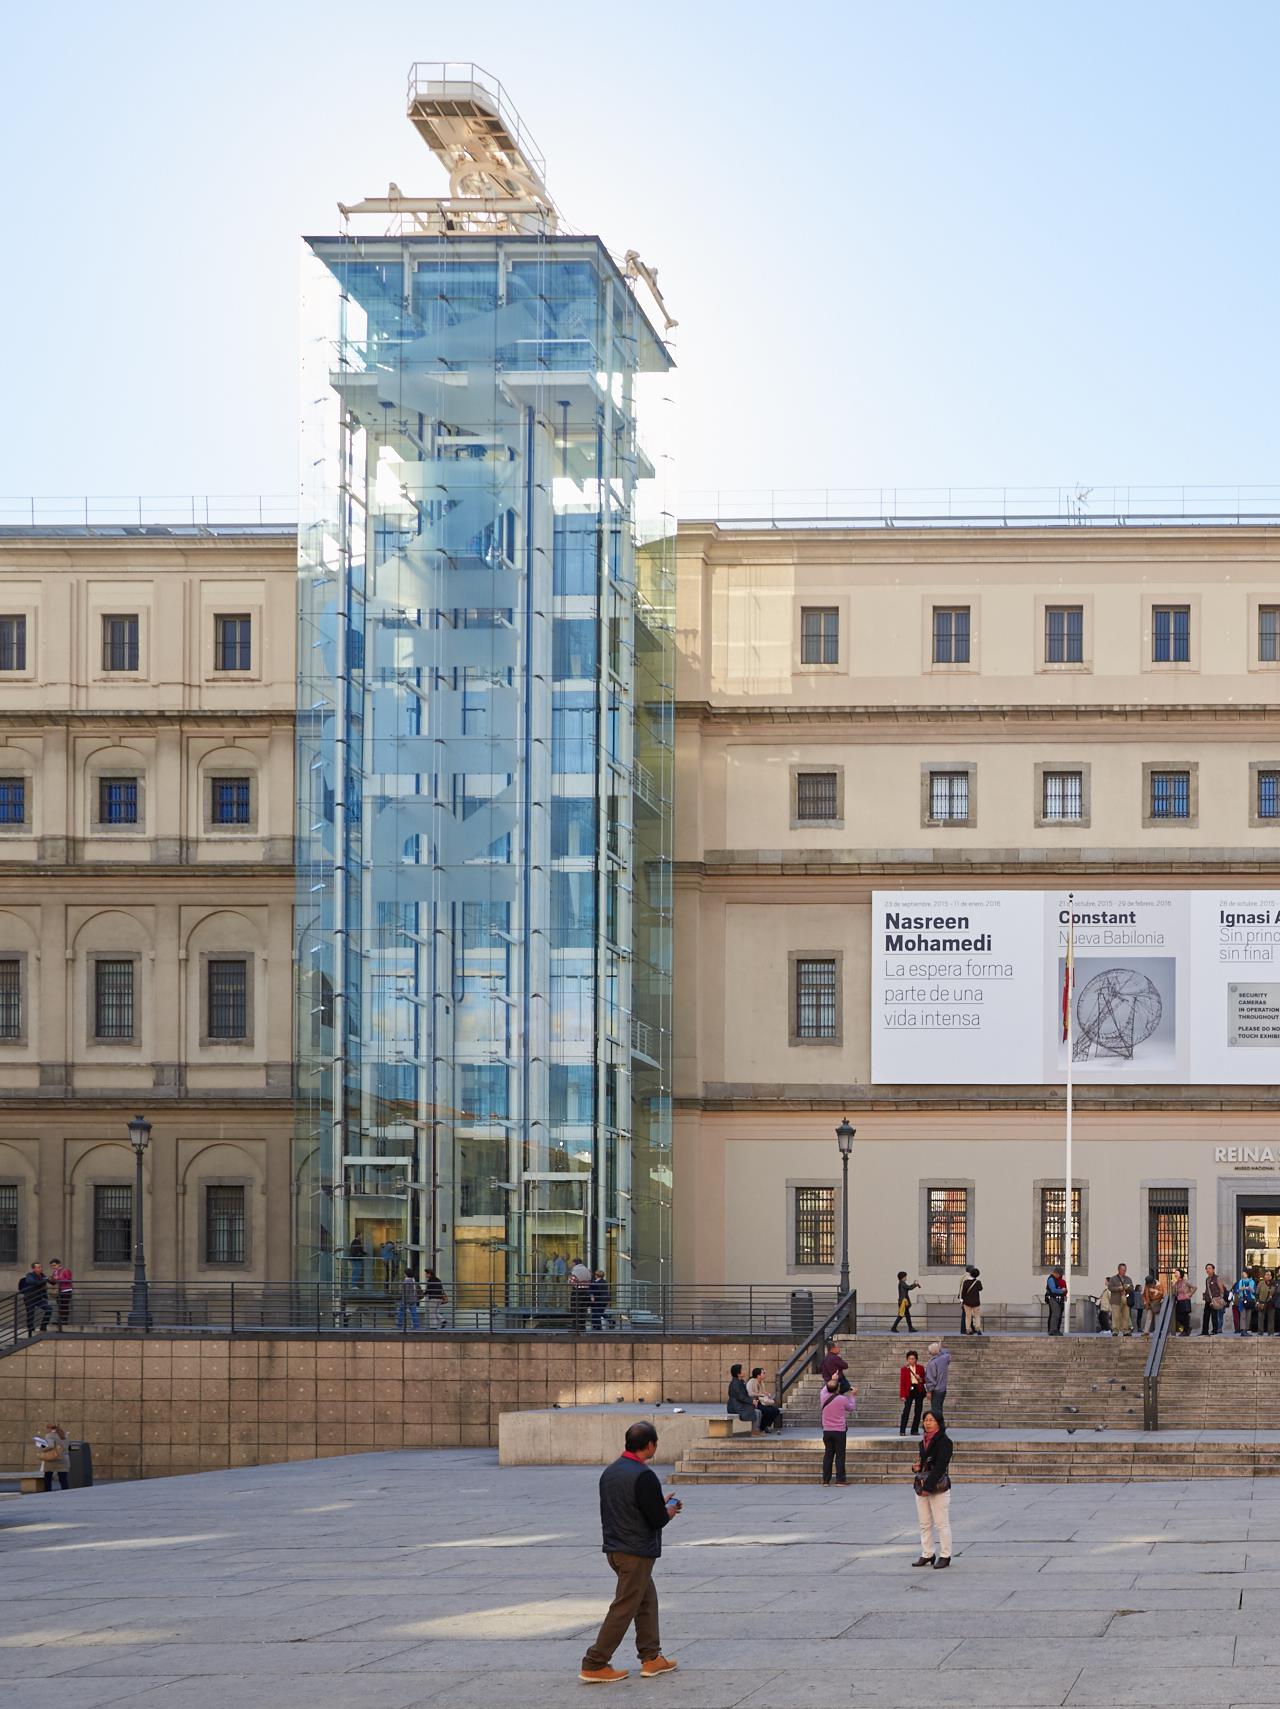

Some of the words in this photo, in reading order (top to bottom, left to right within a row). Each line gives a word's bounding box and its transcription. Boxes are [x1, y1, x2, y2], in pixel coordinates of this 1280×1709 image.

[885, 912, 969, 930] Nasreen
[1058, 910, 1136, 924] Constant
[1220, 910, 1270, 927] Ignasi
[885, 934, 992, 952] Mohamedi
[1058, 931, 1100, 945] Nueva
[1104, 930, 1164, 945] Babilonia
[1220, 928, 1242, 942] Sin
[1220, 946, 1239, 960] sin
[1244, 946, 1273, 960] final
[885, 960, 906, 976] La
[910, 963, 963, 980] espera
[966, 960, 1014, 976] forma
[885, 987, 926, 1005] parte
[929, 985, 950, 1001] de
[954, 988, 983, 1001] una
[885, 1010, 916, 1026] vida
[920, 1010, 980, 1026] intensa
[1215, 1147, 1275, 1162] REINA
